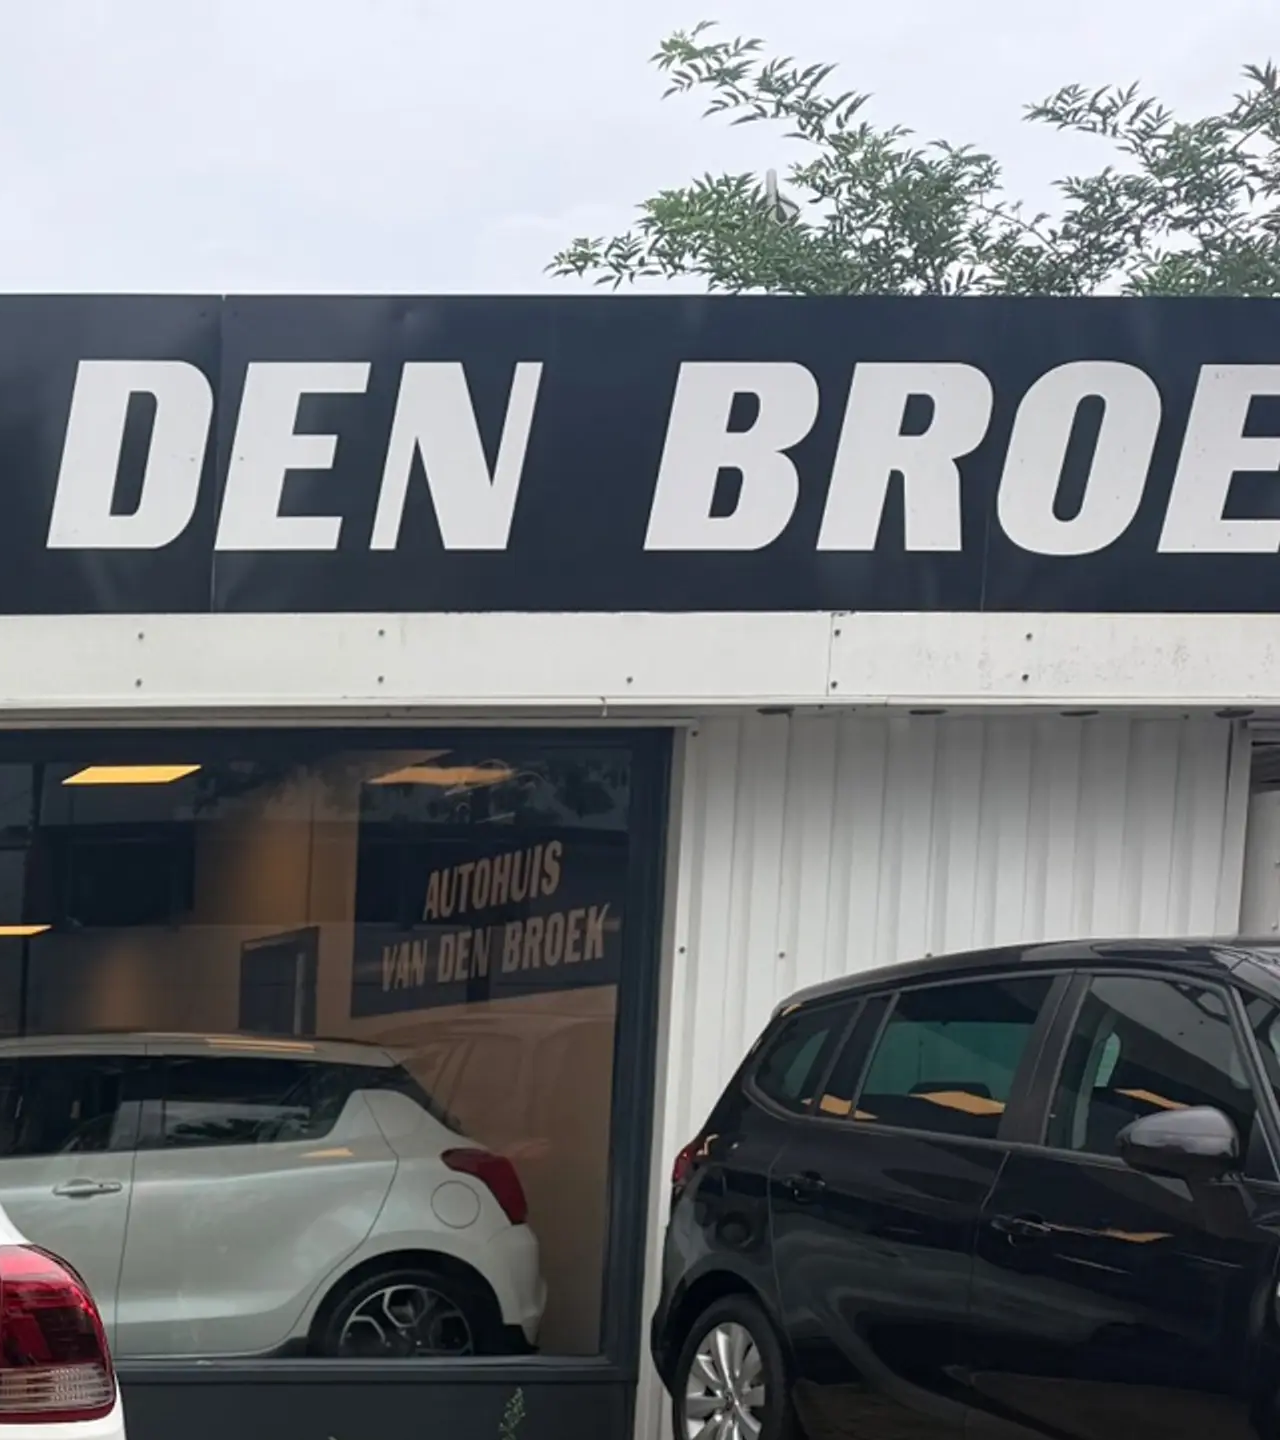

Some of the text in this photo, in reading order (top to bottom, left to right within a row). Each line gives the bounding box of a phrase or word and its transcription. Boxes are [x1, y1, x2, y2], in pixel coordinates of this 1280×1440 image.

[46, 359, 544, 551] DEN
[643, 360, 1280, 556] BROE
[423, 840, 562, 921] AUTOHUIS
[382, 902, 611, 992] VAN DEN BROEK
